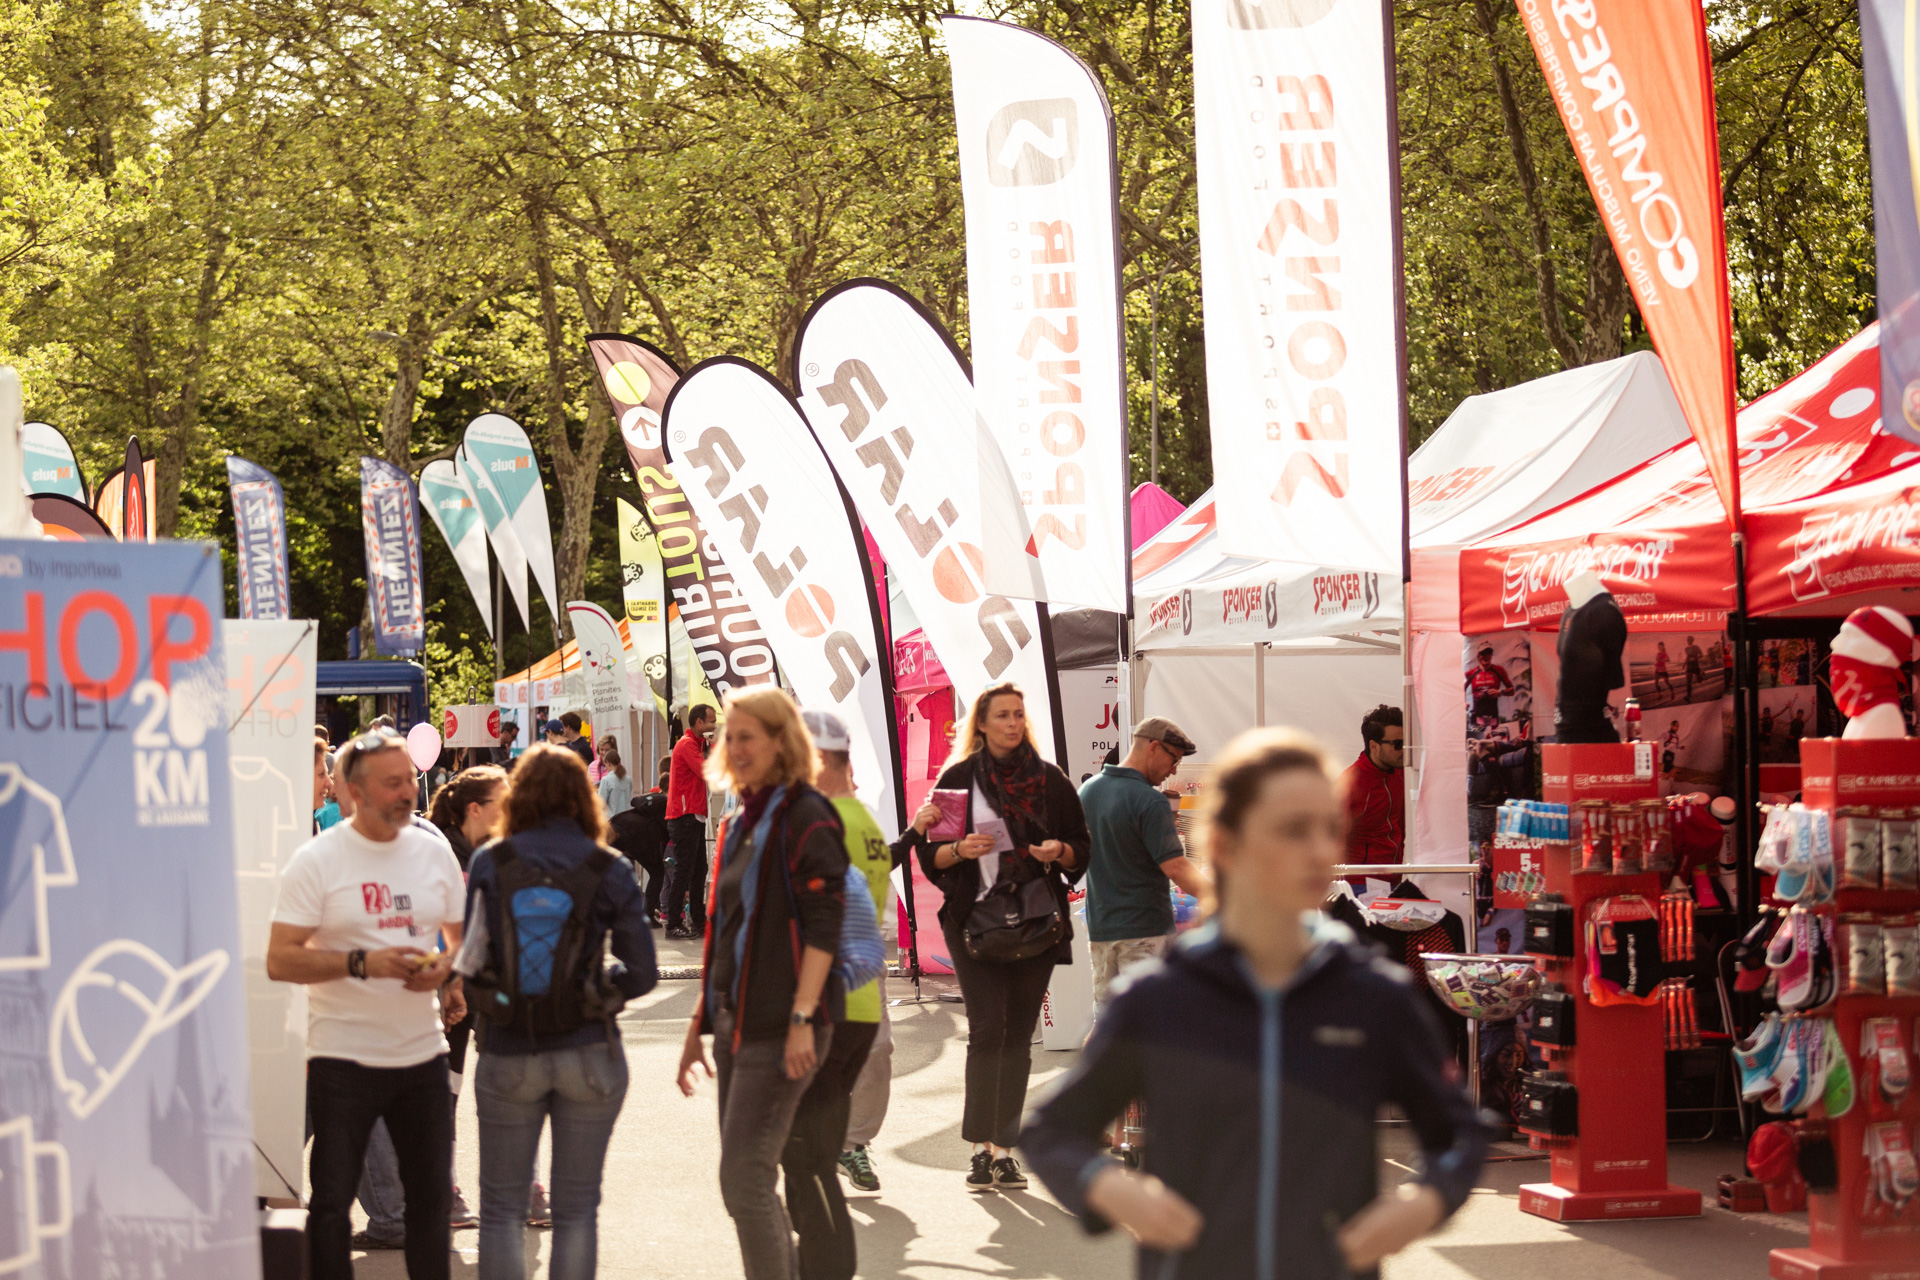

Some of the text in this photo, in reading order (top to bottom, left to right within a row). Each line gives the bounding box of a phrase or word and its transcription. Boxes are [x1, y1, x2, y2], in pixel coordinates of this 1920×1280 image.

[1222, 585, 1263, 625] SPONSER
[1313, 572, 1362, 615] SPONSER
[133, 749, 209, 807] KM
